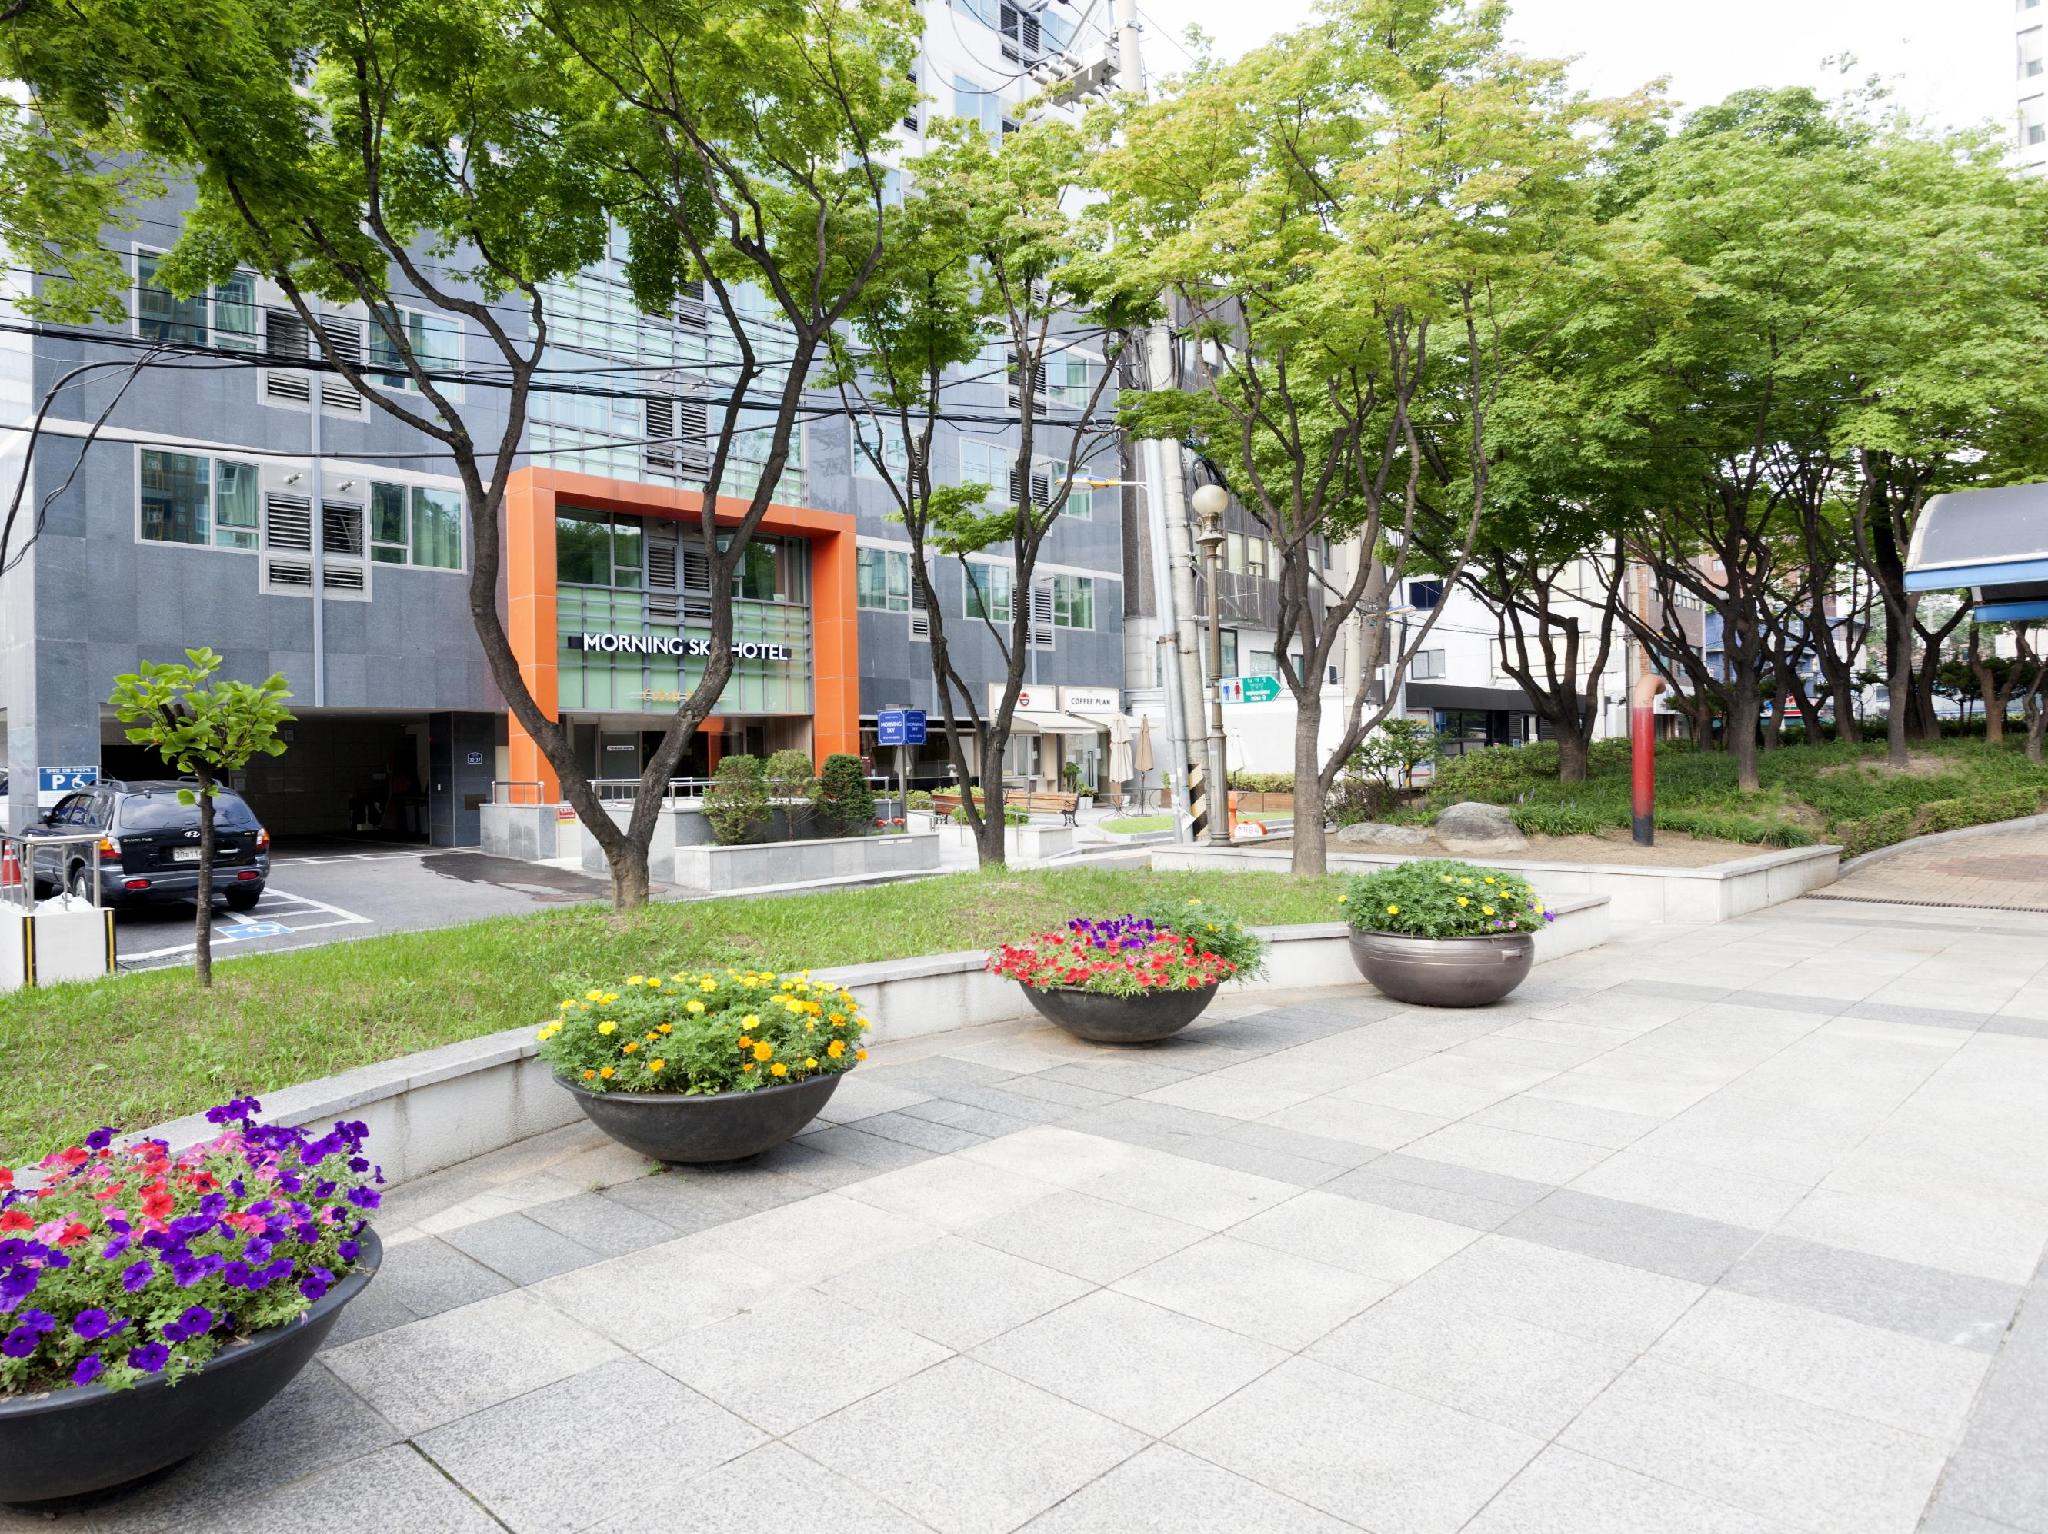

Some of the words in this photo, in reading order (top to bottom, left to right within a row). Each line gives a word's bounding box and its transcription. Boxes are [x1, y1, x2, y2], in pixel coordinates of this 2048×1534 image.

[583, 632, 683, 655] MORNING
[689, 638, 711, 656] SK
[731, 641, 788, 661] HOTEL
[1071, 697, 1093, 705] COFFEE
[52, 774, 66, 789] P
